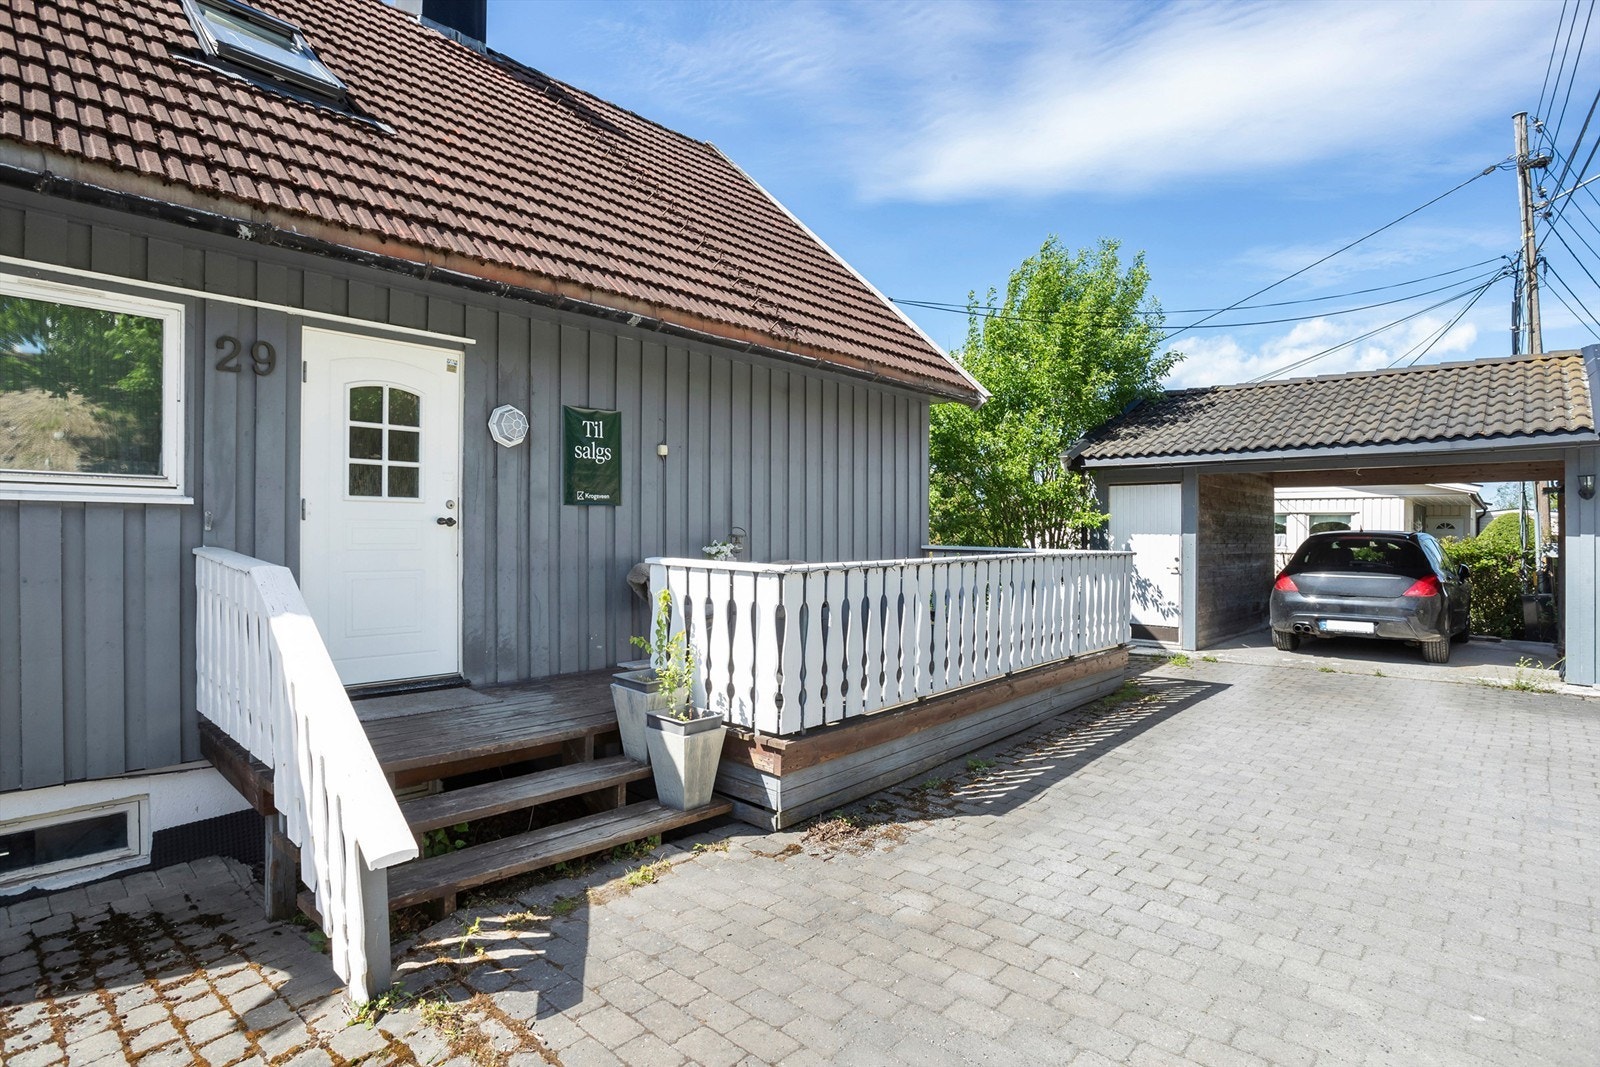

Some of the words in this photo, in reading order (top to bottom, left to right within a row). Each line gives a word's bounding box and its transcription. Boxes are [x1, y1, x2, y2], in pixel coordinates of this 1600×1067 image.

[215, 335, 276, 376] 29
[582, 420, 604, 438] Til
[574, 441, 612, 465] salgs
